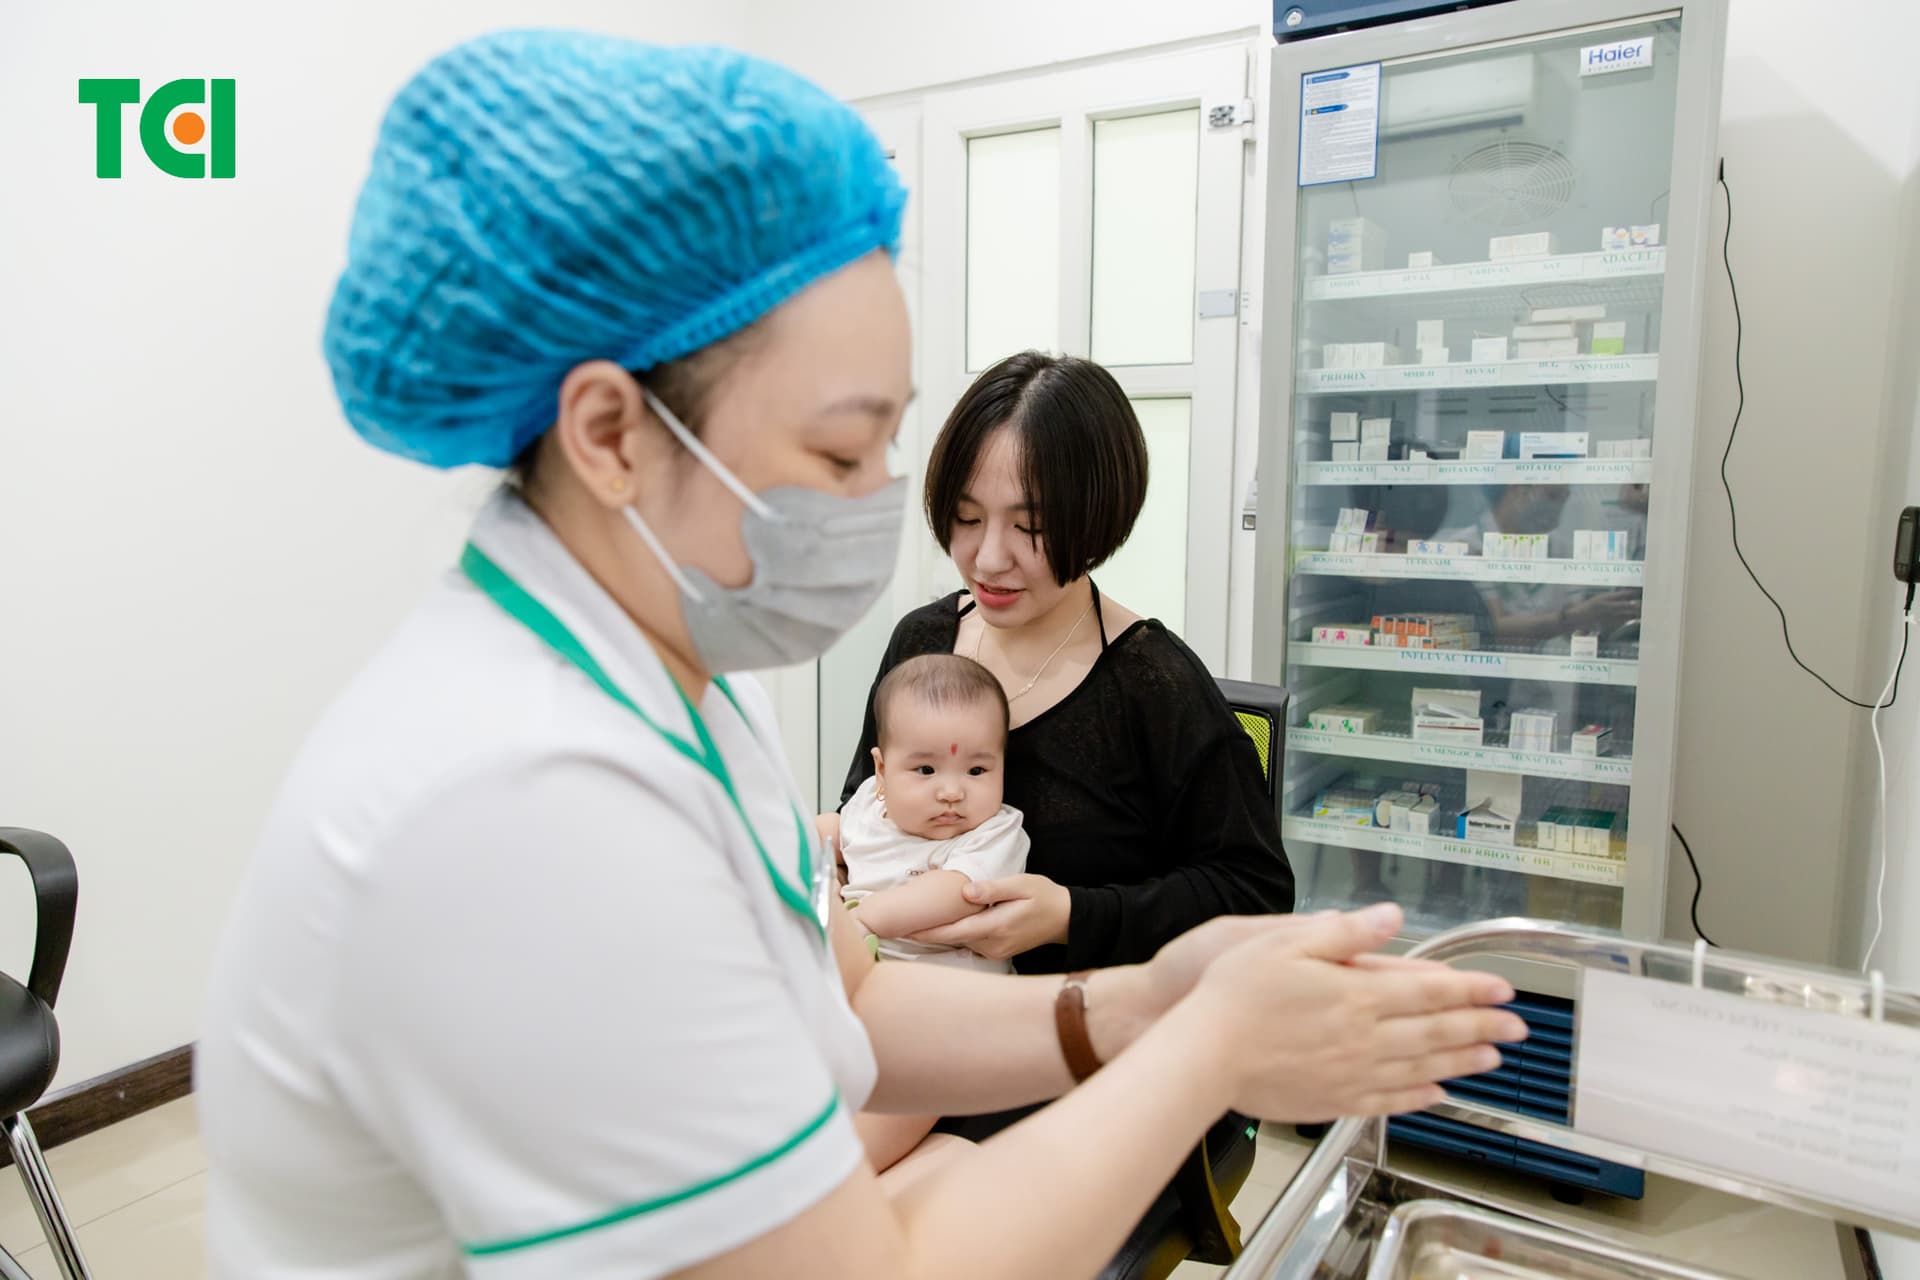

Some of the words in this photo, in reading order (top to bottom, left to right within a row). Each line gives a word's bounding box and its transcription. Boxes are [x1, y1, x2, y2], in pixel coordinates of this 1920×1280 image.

[1588, 44, 1643, 65] Haier
[1601, 250, 1656, 265] ADACEL
[1320, 371, 1367, 382] PRIORIX
[1515, 463, 1561, 473] ROTATEQ
[1401, 651, 1456, 662] INFLUVAC
[1463, 654, 1501, 665] TETRA
